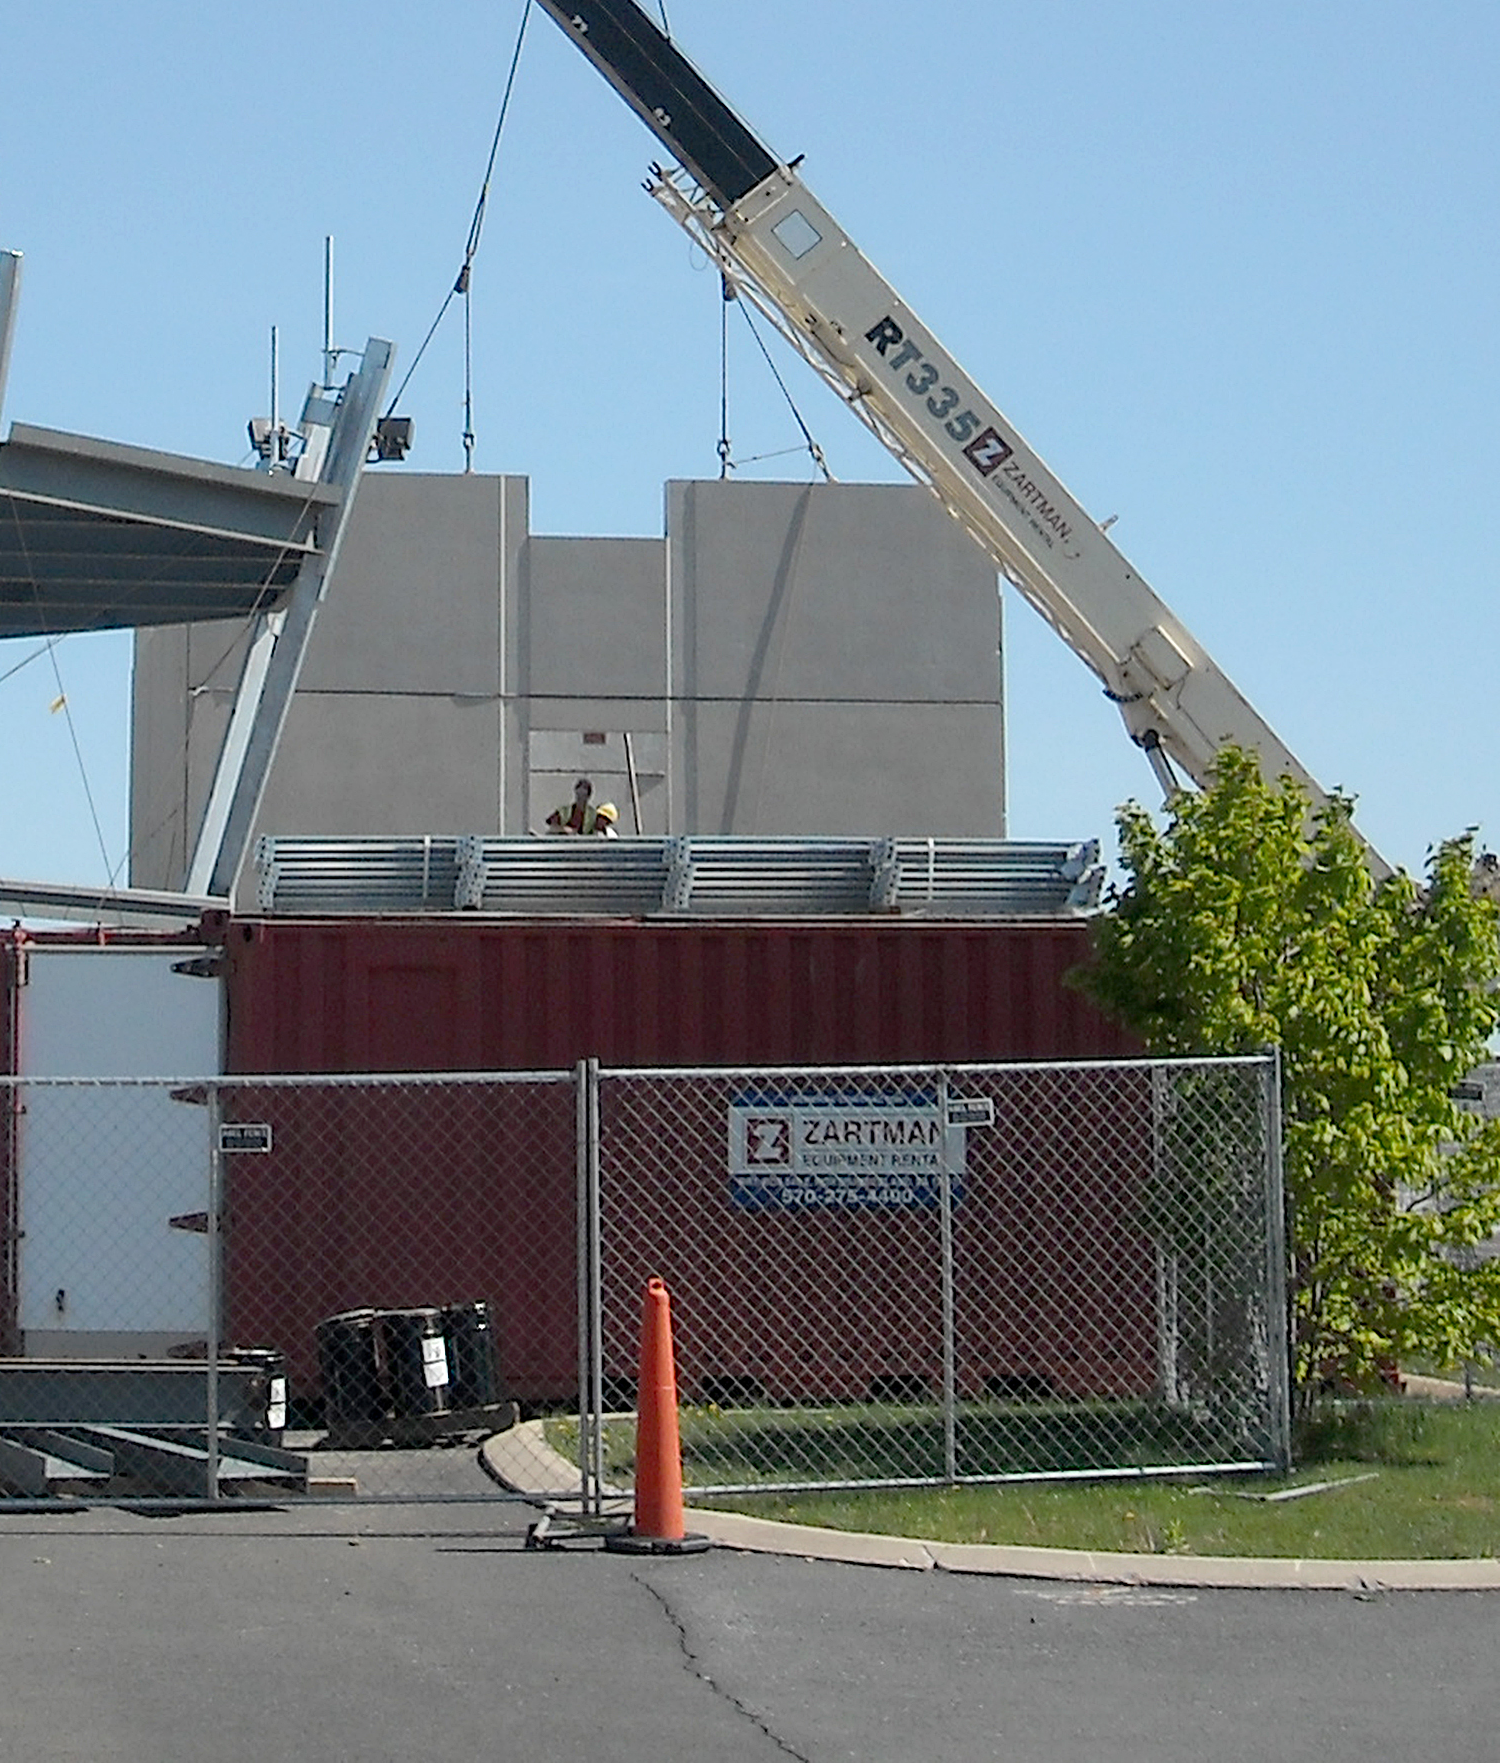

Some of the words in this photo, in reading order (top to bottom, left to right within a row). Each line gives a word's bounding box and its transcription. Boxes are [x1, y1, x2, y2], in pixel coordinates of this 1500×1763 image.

[864, 315, 982, 443] RT335
[802, 1153, 885, 1167] EQUIPMENT
[890, 1153, 940, 1167] RENTA
